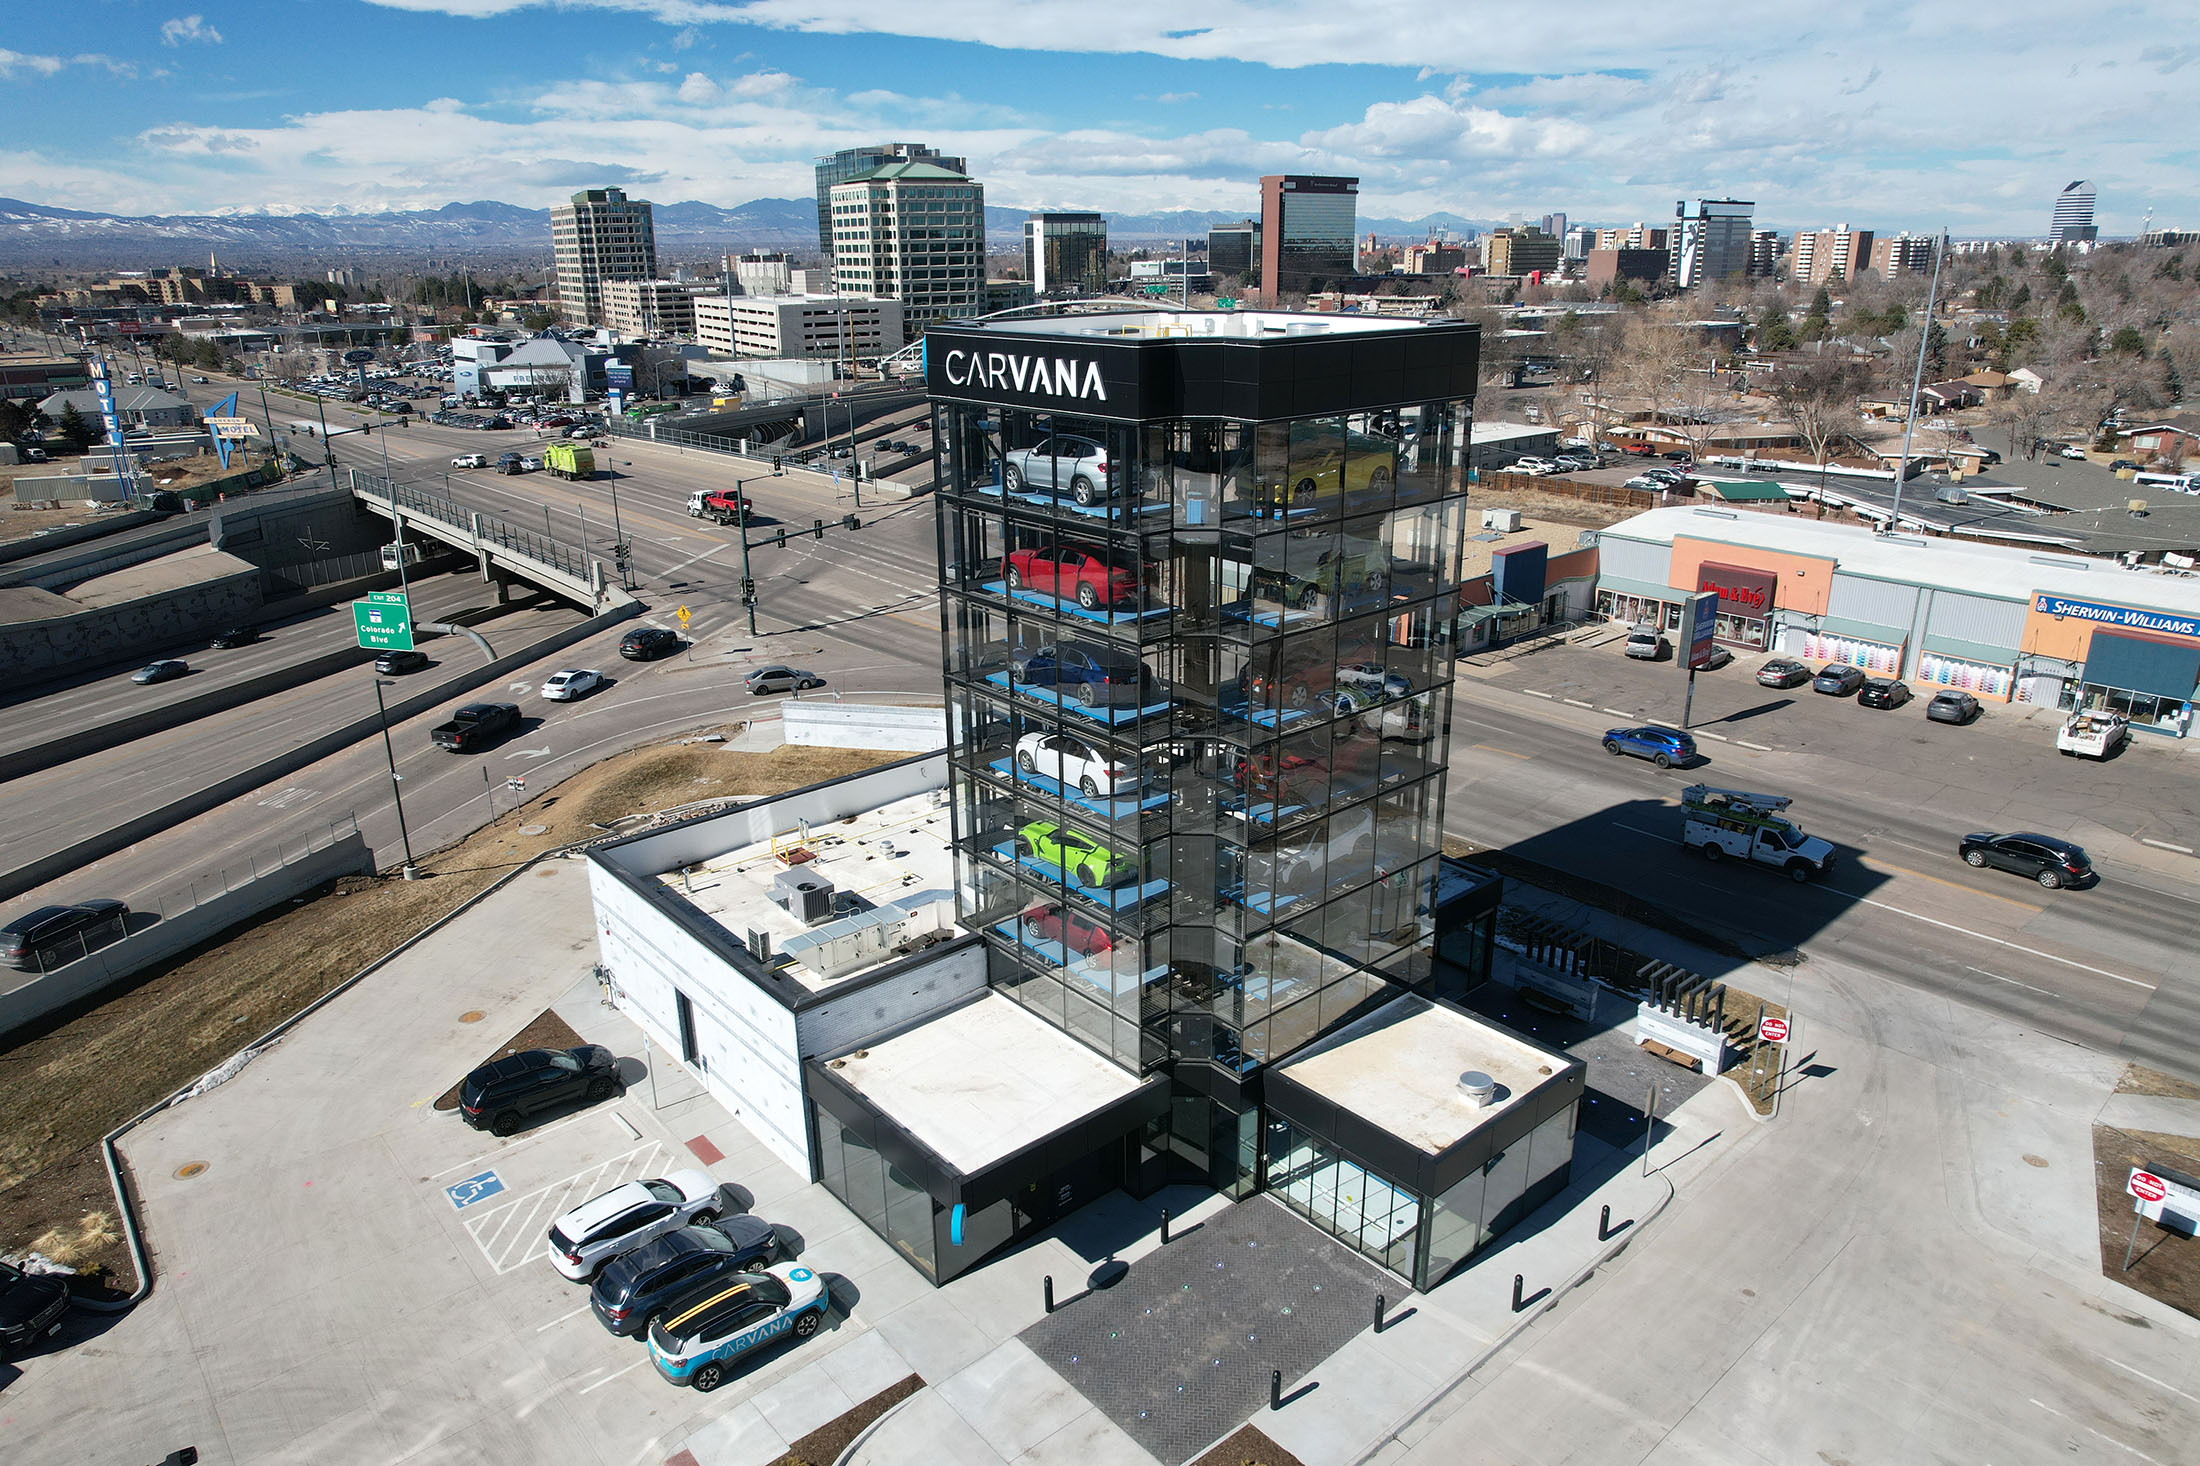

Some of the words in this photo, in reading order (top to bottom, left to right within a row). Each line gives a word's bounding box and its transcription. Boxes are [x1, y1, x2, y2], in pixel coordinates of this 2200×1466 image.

[945, 350, 1107, 401] CARVANA
[89, 362, 120, 446] MOTEL
[1729, 586, 1739, 602] &
[2052, 601, 2195, 634] SHERWIN-WILLIAMS
[360, 625, 395, 634] Colorado
[370, 635, 388, 643] Blvd
[2136, 1174, 2147, 1182] DO
[2148, 1179, 2162, 1189] NOT
[2135, 1186, 2157, 1200] ENTER
[711, 1315, 793, 1361] CARVANA
